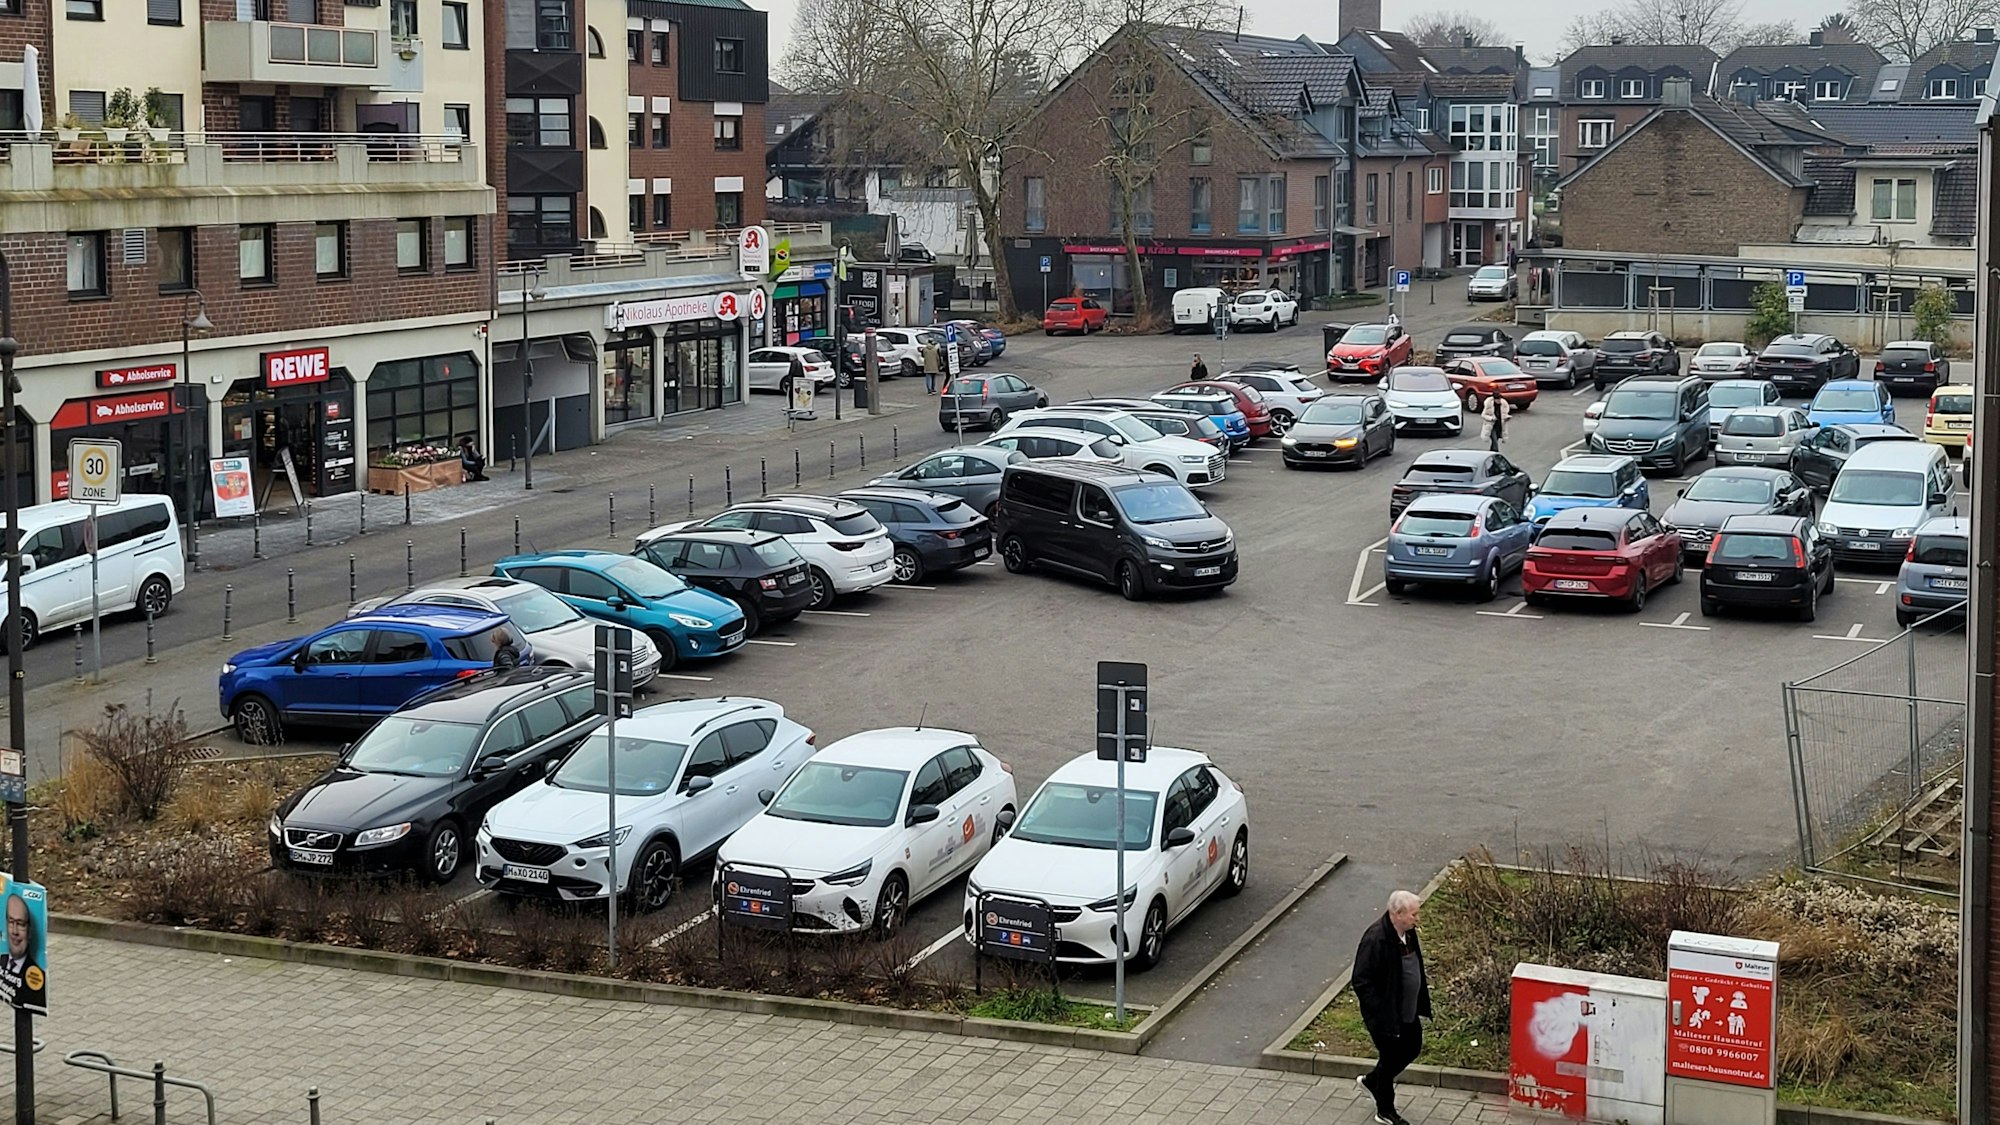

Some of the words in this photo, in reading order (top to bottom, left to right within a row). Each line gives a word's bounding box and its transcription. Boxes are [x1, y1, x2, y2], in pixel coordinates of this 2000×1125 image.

[1399, 272, 1407, 284] P
[1792, 273, 1801, 285] P
[624, 305, 662, 321] Nikolaus
[665, 301, 708, 320] Apotheke
[947, 325, 954, 341] P
[126, 367, 171, 382] Abholservice
[271, 353, 326, 382] REWE
[115, 399, 165, 416] Abholservice
[86, 458, 104, 475] 30
[82, 487, 106, 498] ZONE
[318, 854, 332, 864] 272
[528, 869, 548, 880] 2140
[740, 885, 772, 897] Ehrenfried
[999, 916, 1033, 928] Ehrenfried
[1744, 962, 1770, 971] Malteser
[1671, 972, 1698, 981] Gestürzt
[1704, 977, 1734, 986] Gedrückt
[1740, 981, 1770, 990] Geholfen
[1673, 1029, 1711, 1041] Malteser
[1713, 1034, 1763, 1048] Hausnotruf
[1689, 1045, 1714, 1056] 0800
[1716, 1048, 1759, 1062] 9966007
[1672, 1060, 1765, 1080] malteser-hausnotruf.de
